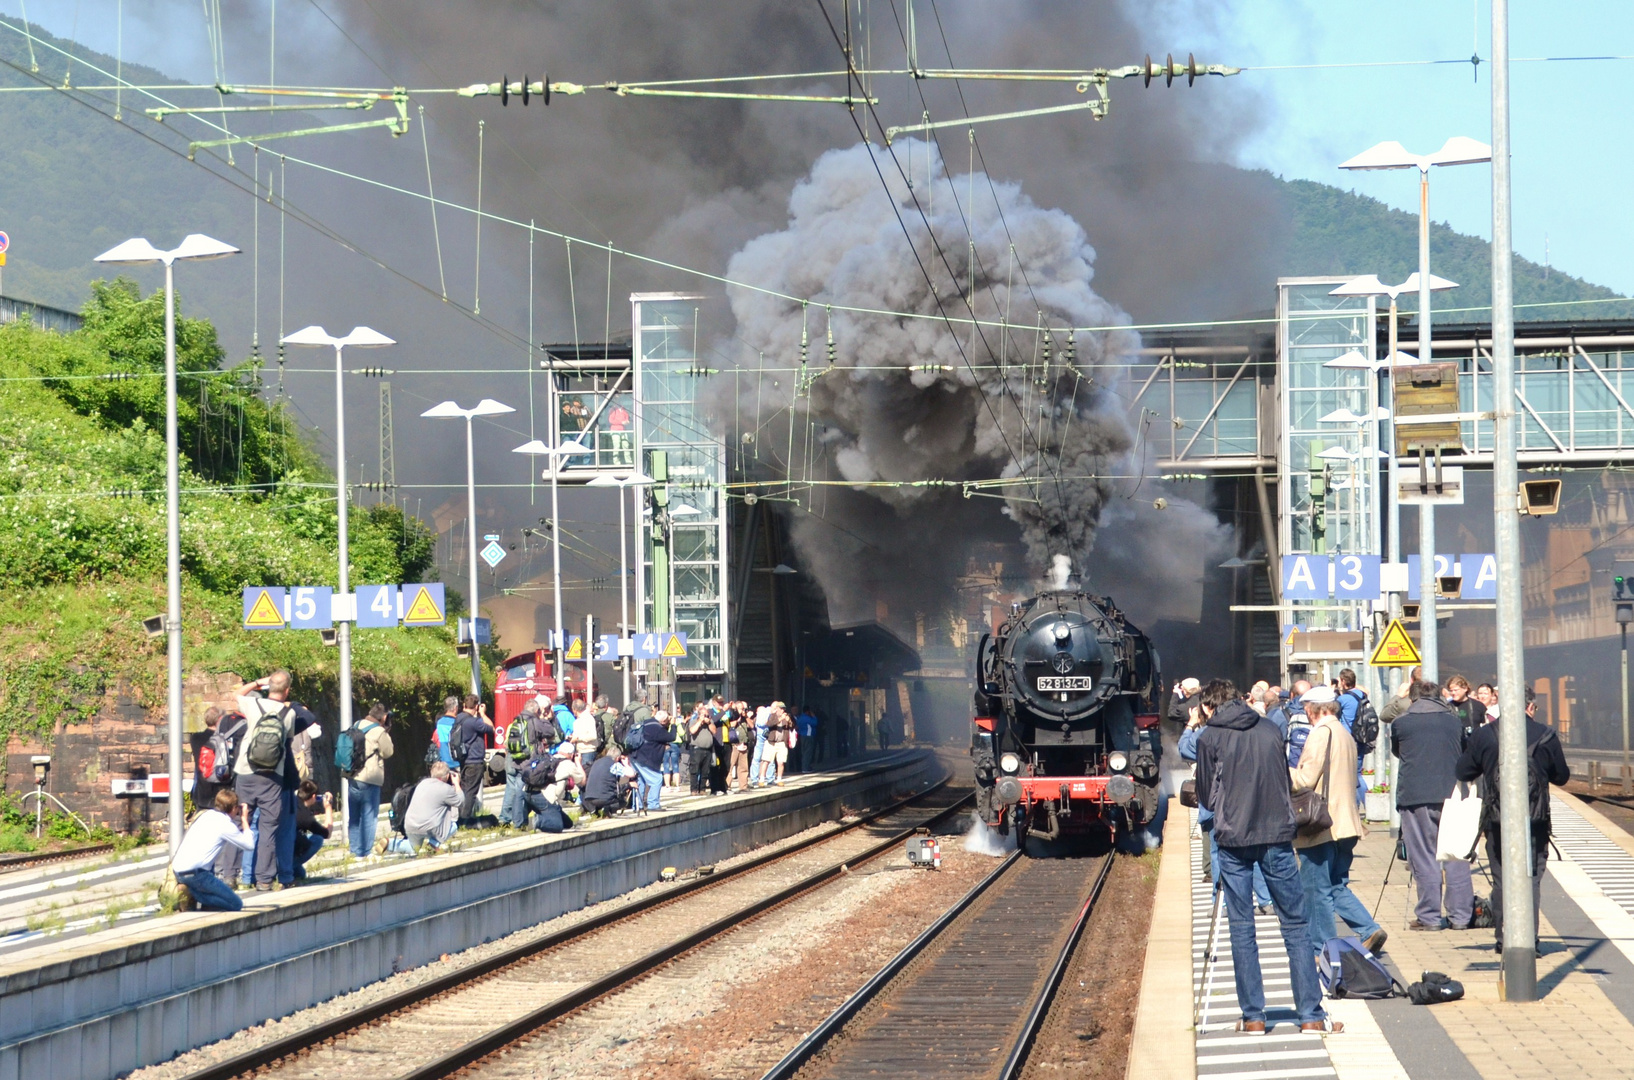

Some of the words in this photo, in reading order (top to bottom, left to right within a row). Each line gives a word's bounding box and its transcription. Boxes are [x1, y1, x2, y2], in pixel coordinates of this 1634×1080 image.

[1286, 556, 1316, 591] A
[1339, 555, 1364, 591] 3
[1474, 555, 1497, 590] A
[295, 587, 317, 621] 5
[370, 585, 393, 619] 4
[599, 634, 609, 656] 5
[641, 633, 656, 655] 4
[1040, 678, 1053, 689] 52
[1054, 678, 1089, 689] 8134-0
